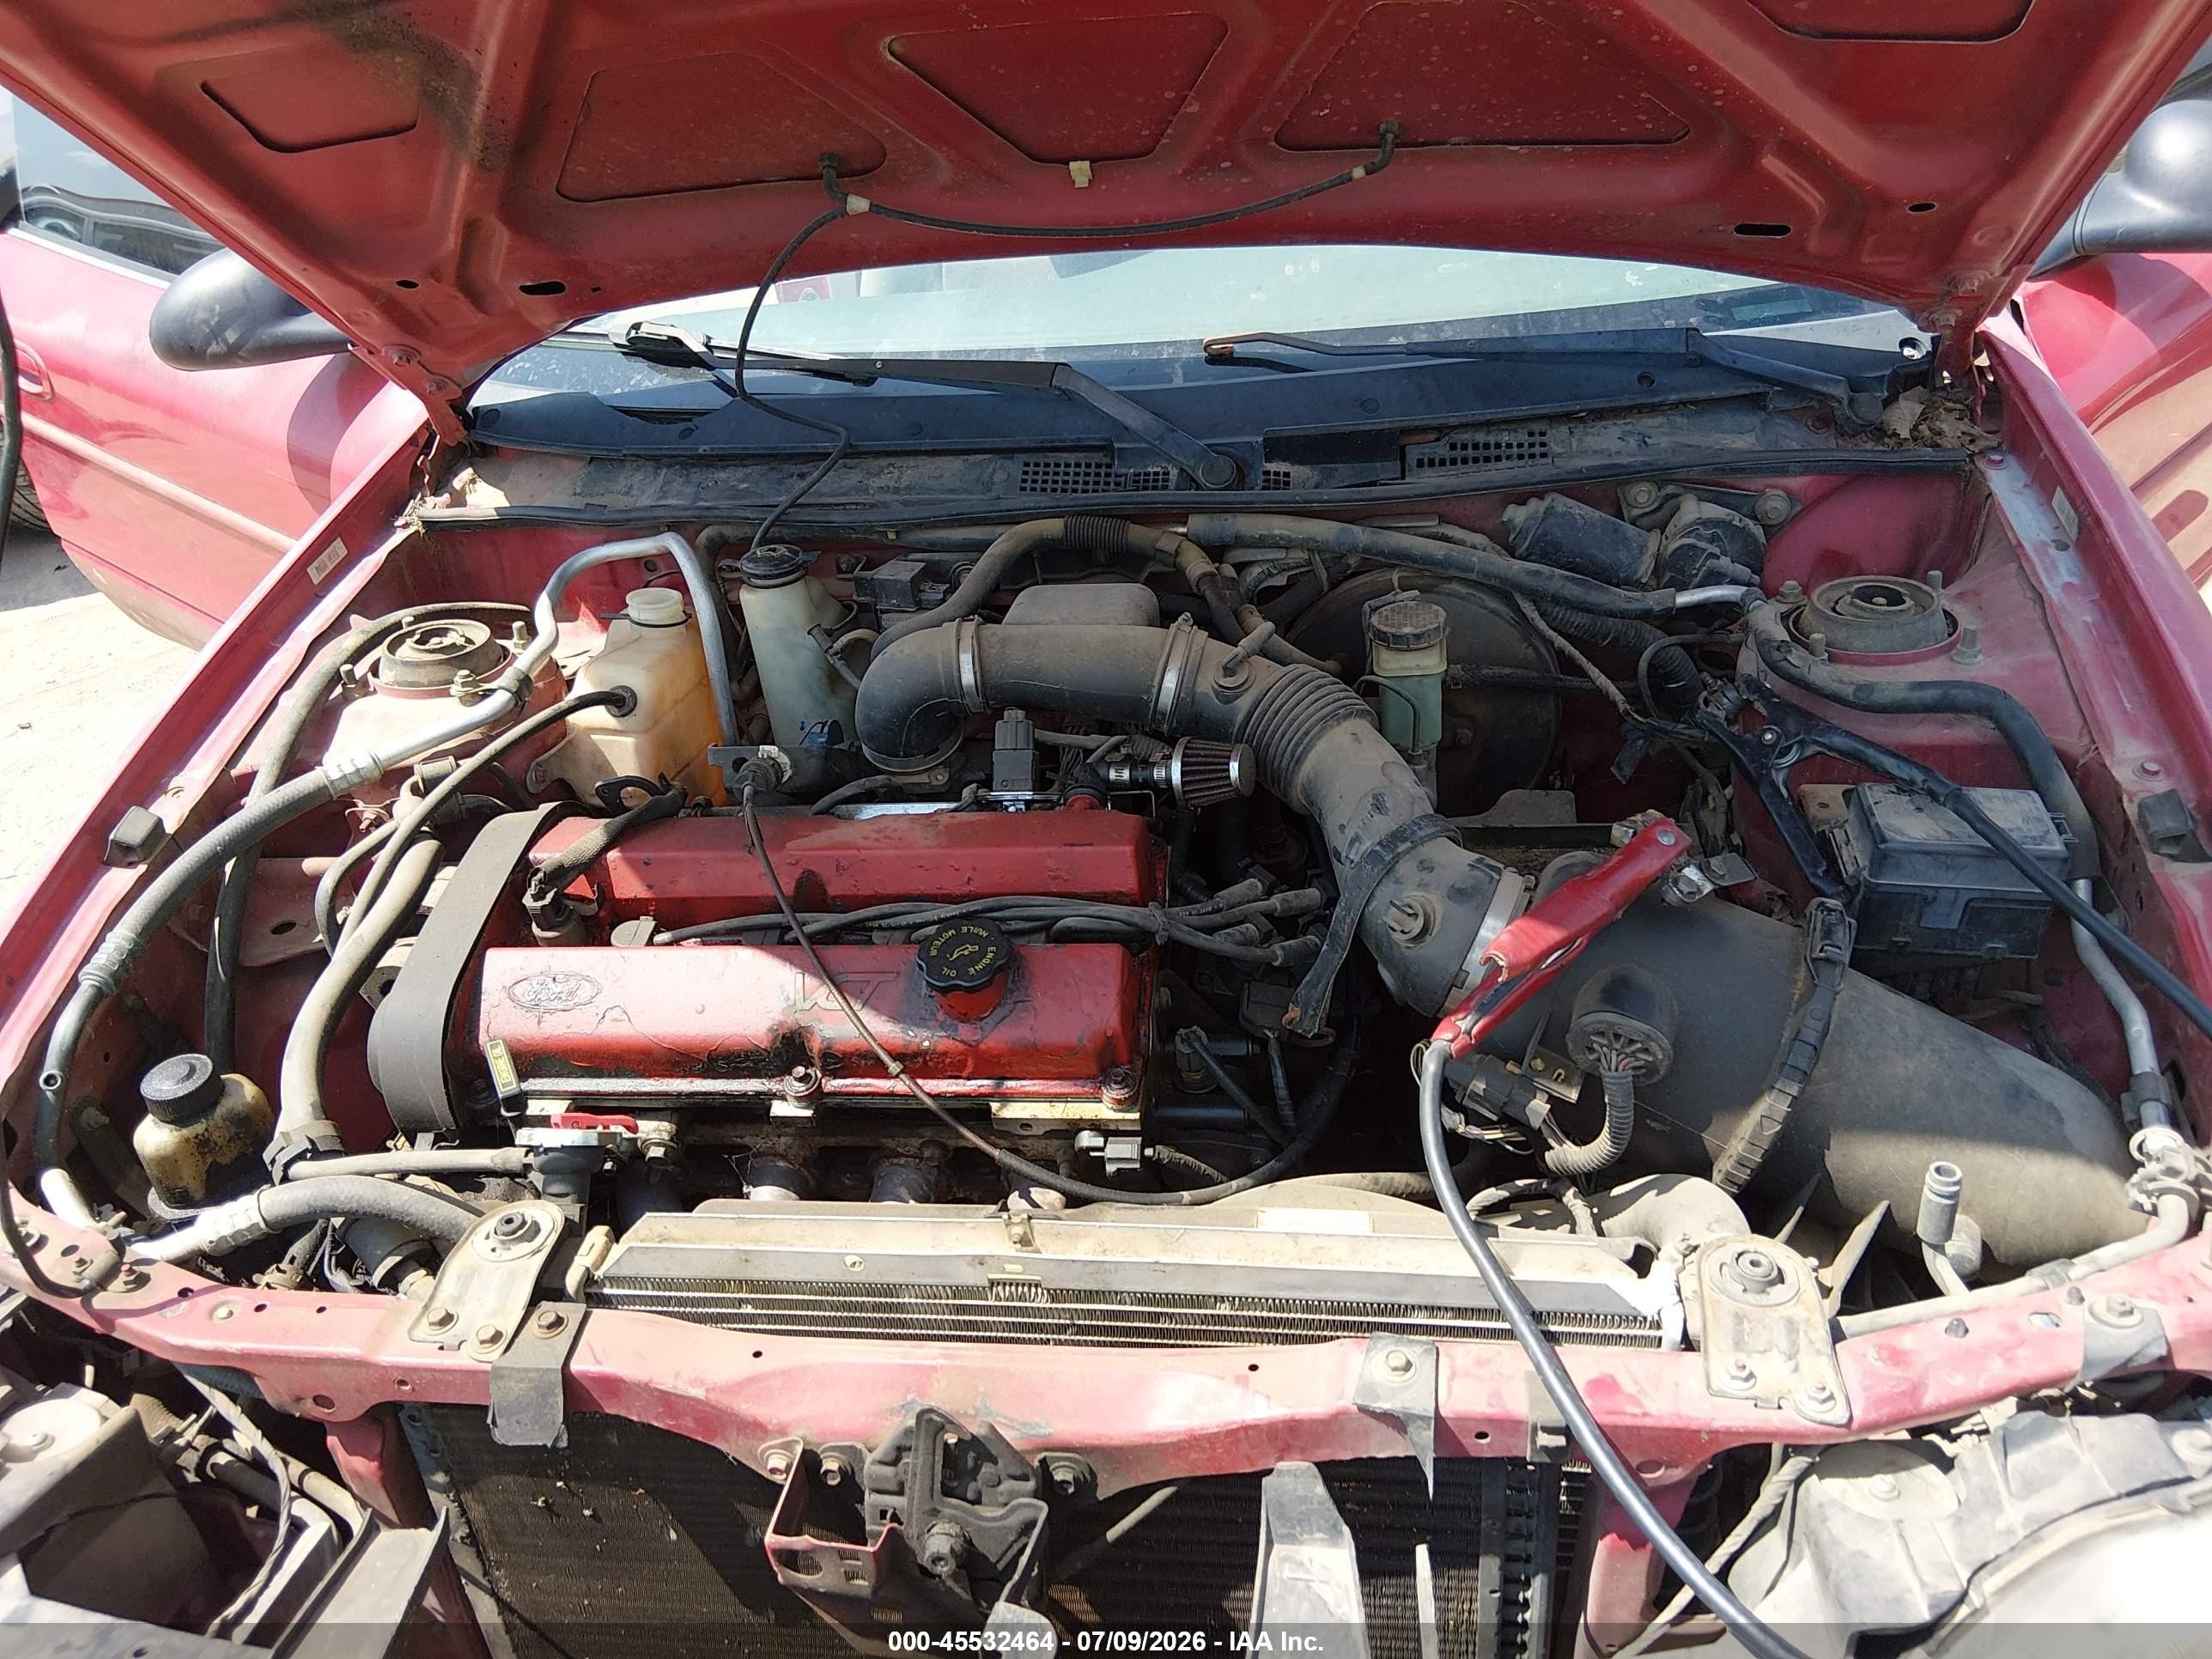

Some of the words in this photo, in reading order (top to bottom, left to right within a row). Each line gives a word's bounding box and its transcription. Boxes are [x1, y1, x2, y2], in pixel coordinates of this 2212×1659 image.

[961, 926, 989, 938] HUILE
[929, 928, 957, 957] MOTEUR
[967, 946, 996, 975] ENGINE
[941, 966, 957, 977] OIL
